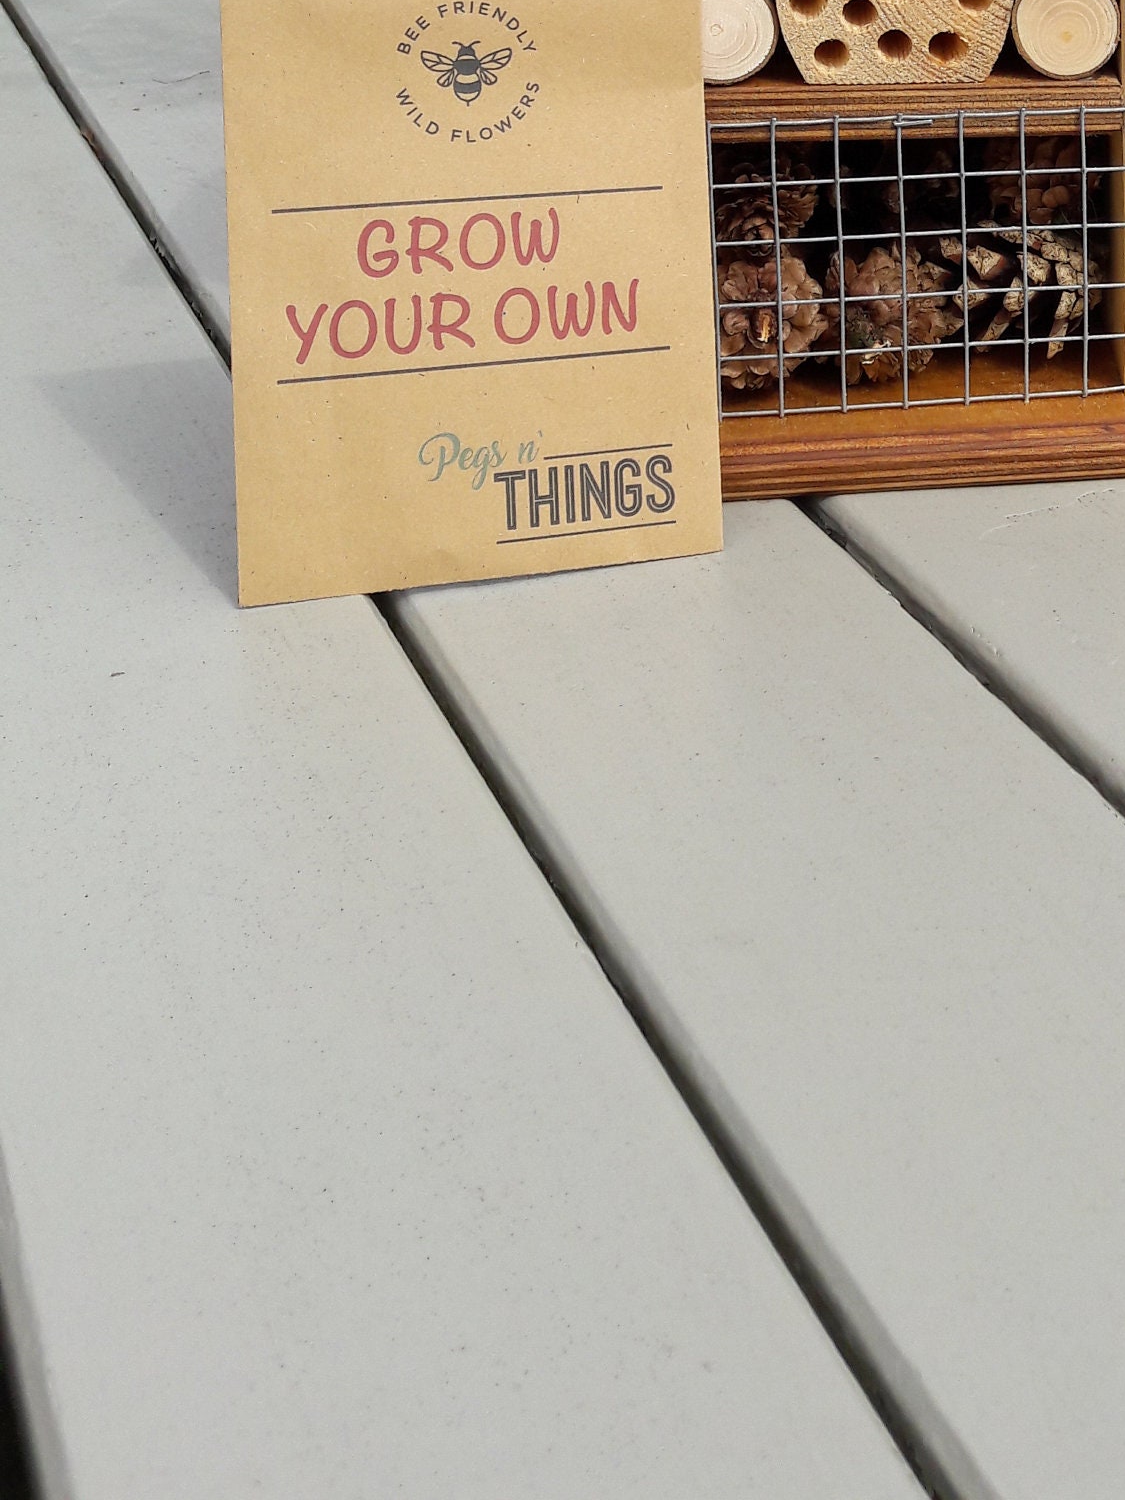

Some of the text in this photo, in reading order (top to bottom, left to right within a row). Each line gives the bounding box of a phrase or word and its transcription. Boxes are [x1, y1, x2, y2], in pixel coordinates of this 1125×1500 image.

[396, 0, 537, 55] BEE FRIENDLY
[396, 82, 540, 143] WILD FLOWERS
[356, 207, 561, 279] GROW
[285, 278, 641, 365] YOUR OWN
[418, 432, 507, 490] Pegs
[494, 454, 675, 530] THINGS
